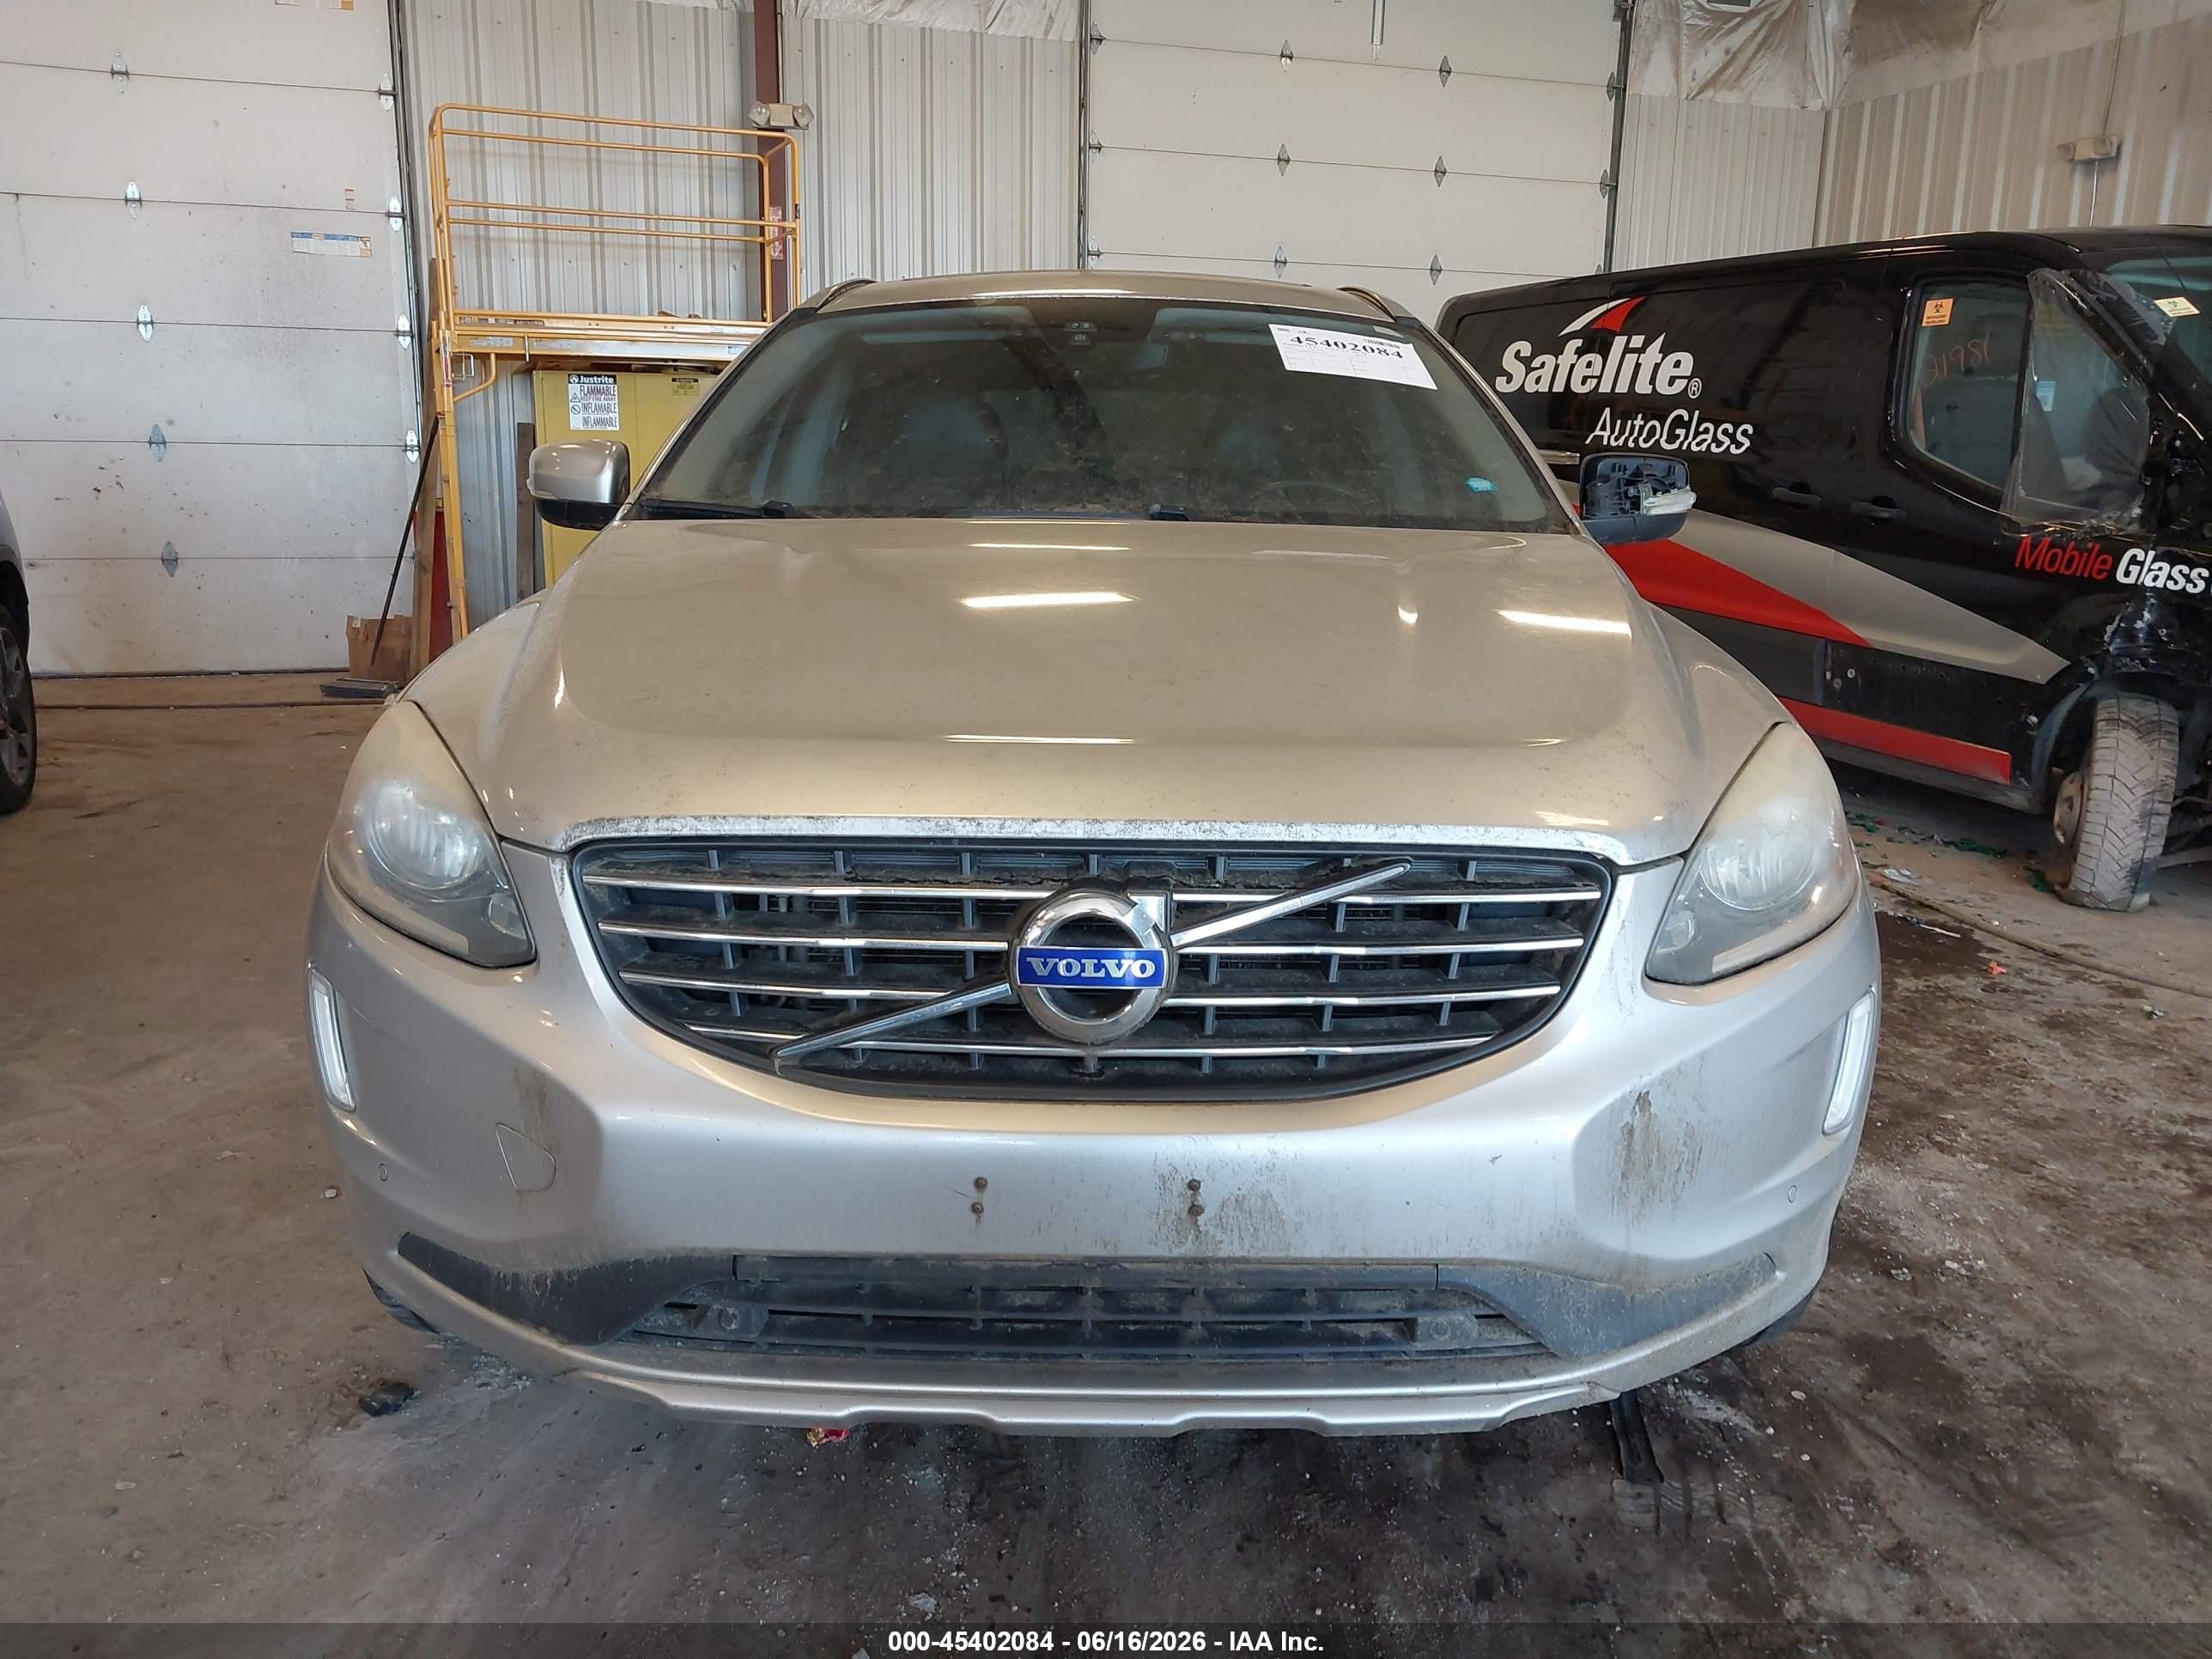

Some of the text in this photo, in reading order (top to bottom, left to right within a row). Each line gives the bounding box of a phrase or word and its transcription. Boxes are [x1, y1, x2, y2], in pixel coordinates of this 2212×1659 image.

[1291, 336, 1403, 358] 45402084
[580, 385, 616, 396] FLAMMABLE
[581, 402, 617, 413] INFLAMABLE
[582, 416, 617, 427] INFLAMMABLE
[1585, 407, 1753, 454] AutoGlass
[2014, 536, 2209, 593] Mobile Glass
[1026, 957, 1156, 978] VOLVO
